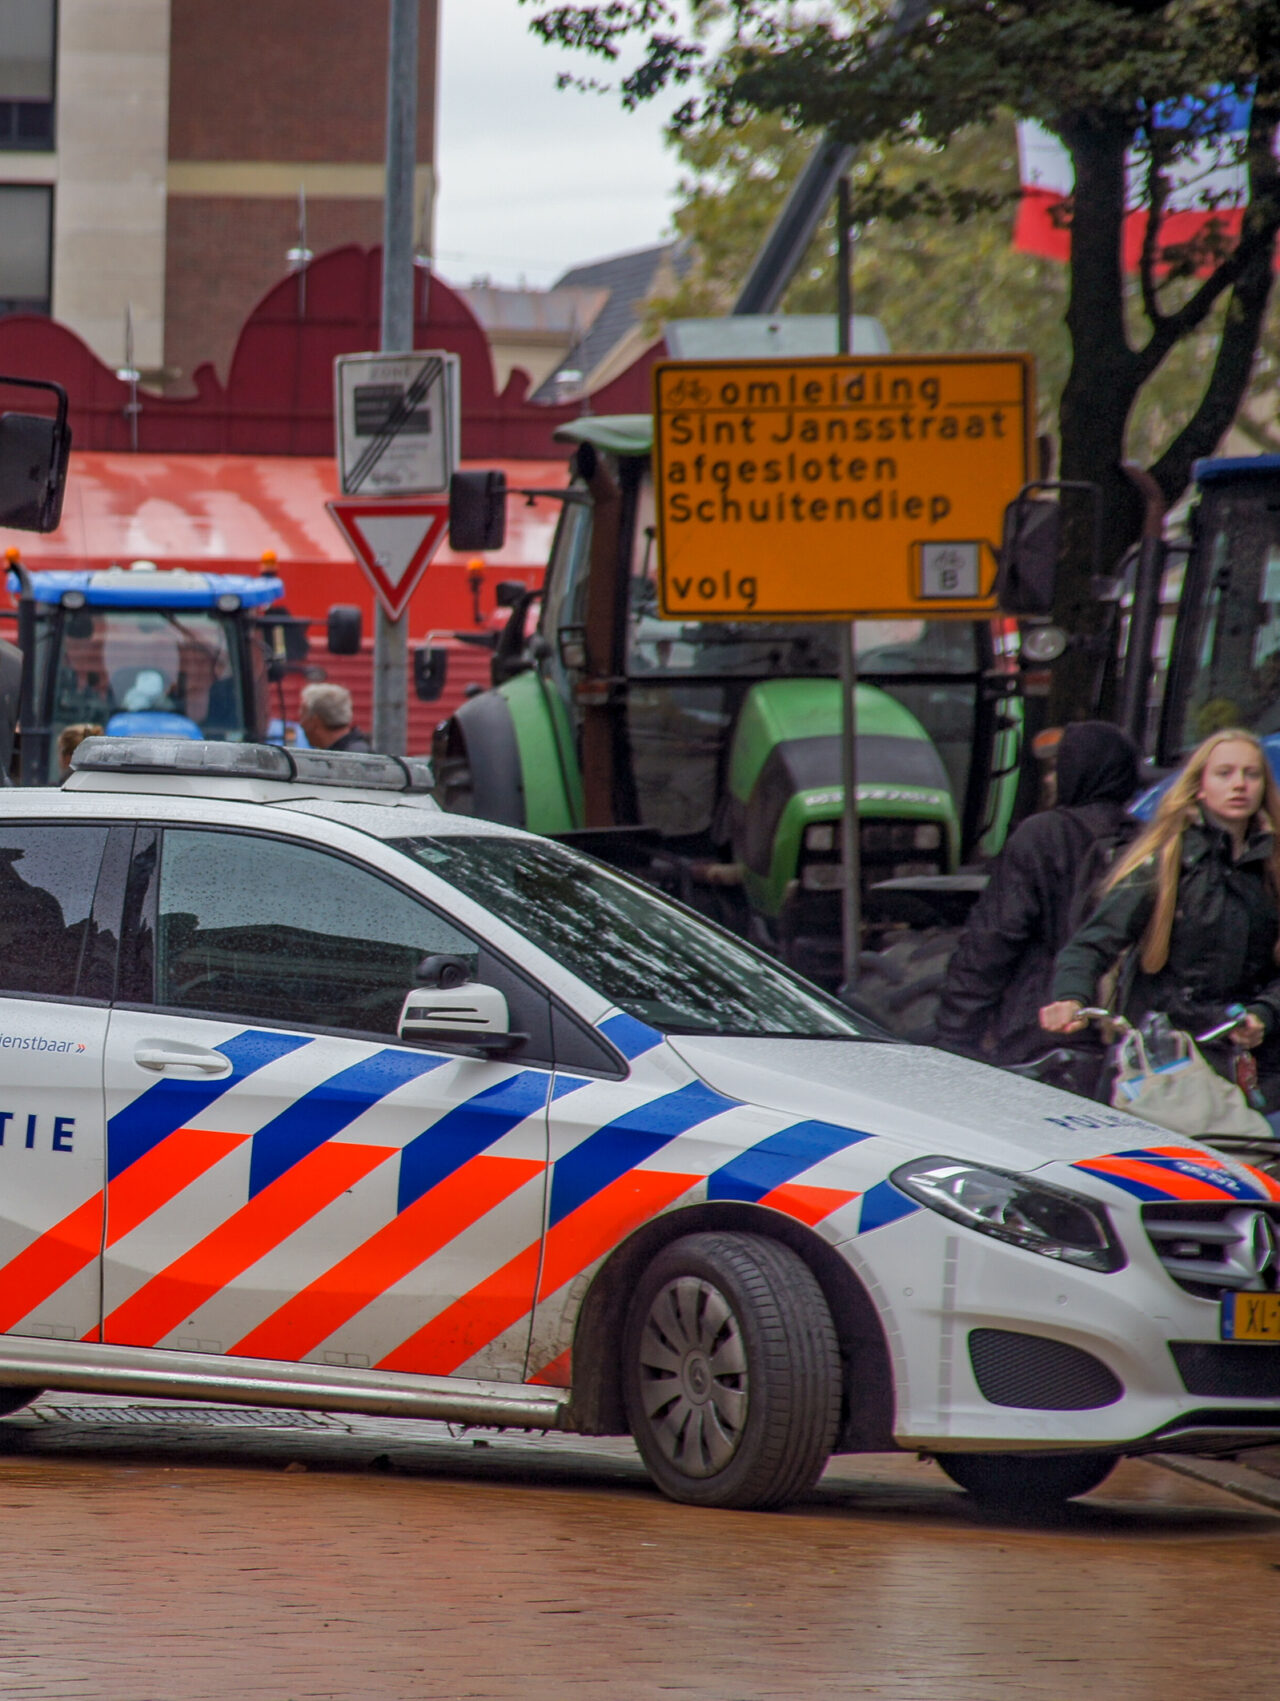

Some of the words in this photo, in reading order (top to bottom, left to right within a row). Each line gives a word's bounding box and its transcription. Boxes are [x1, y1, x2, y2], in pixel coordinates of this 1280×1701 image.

[720, 371, 941, 409] omleiding
[670, 412, 756, 445] Sint
[772, 408, 1007, 444] Jansstraat
[668, 452, 898, 493] afgesloten
[669, 490, 951, 525] Schuitendiep
[672, 569, 758, 610] volg
[939, 569, 959, 591] B
